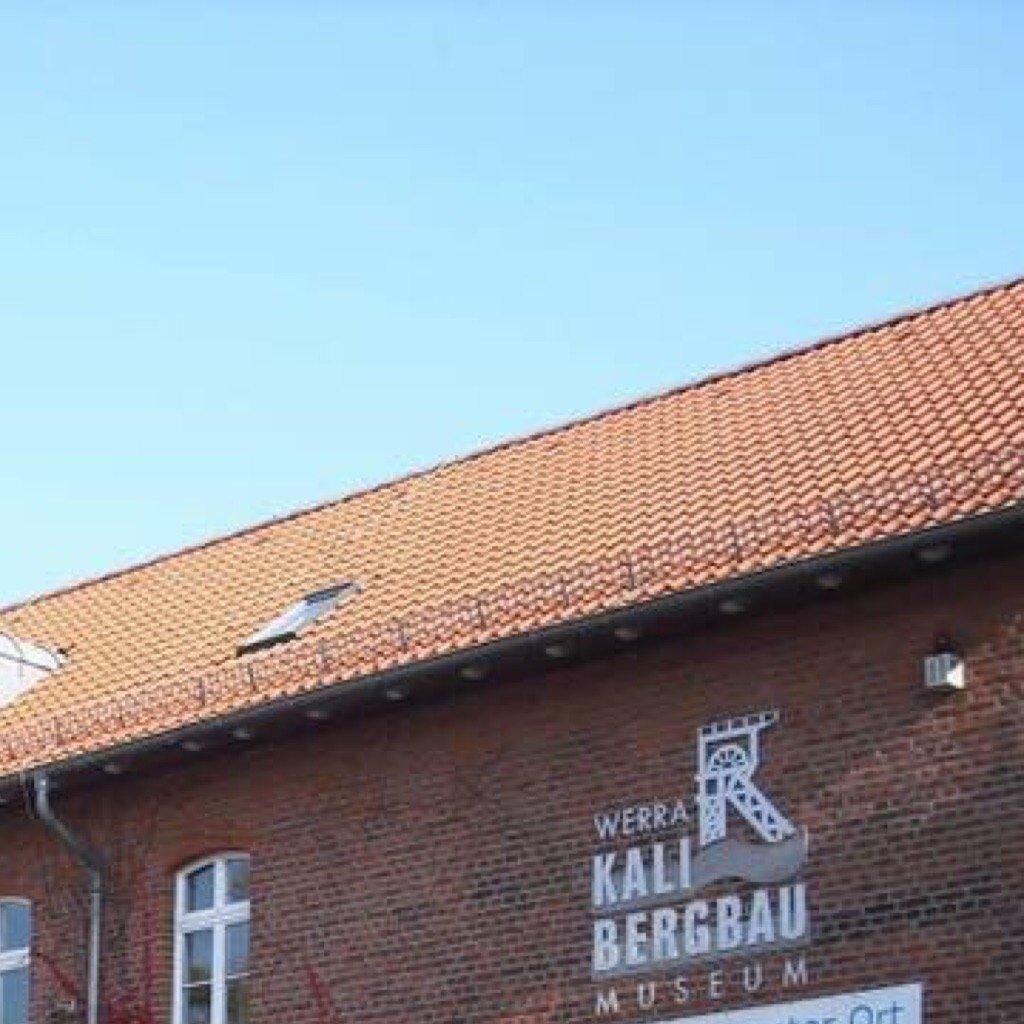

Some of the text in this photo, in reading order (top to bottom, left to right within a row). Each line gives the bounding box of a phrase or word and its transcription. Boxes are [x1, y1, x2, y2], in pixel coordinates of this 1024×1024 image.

[593, 802, 688, 839] WERRA
[593, 838, 692, 906] KALI
[593, 884, 807, 971] BERGBAU
[595, 957, 809, 1016] MUSEUM
